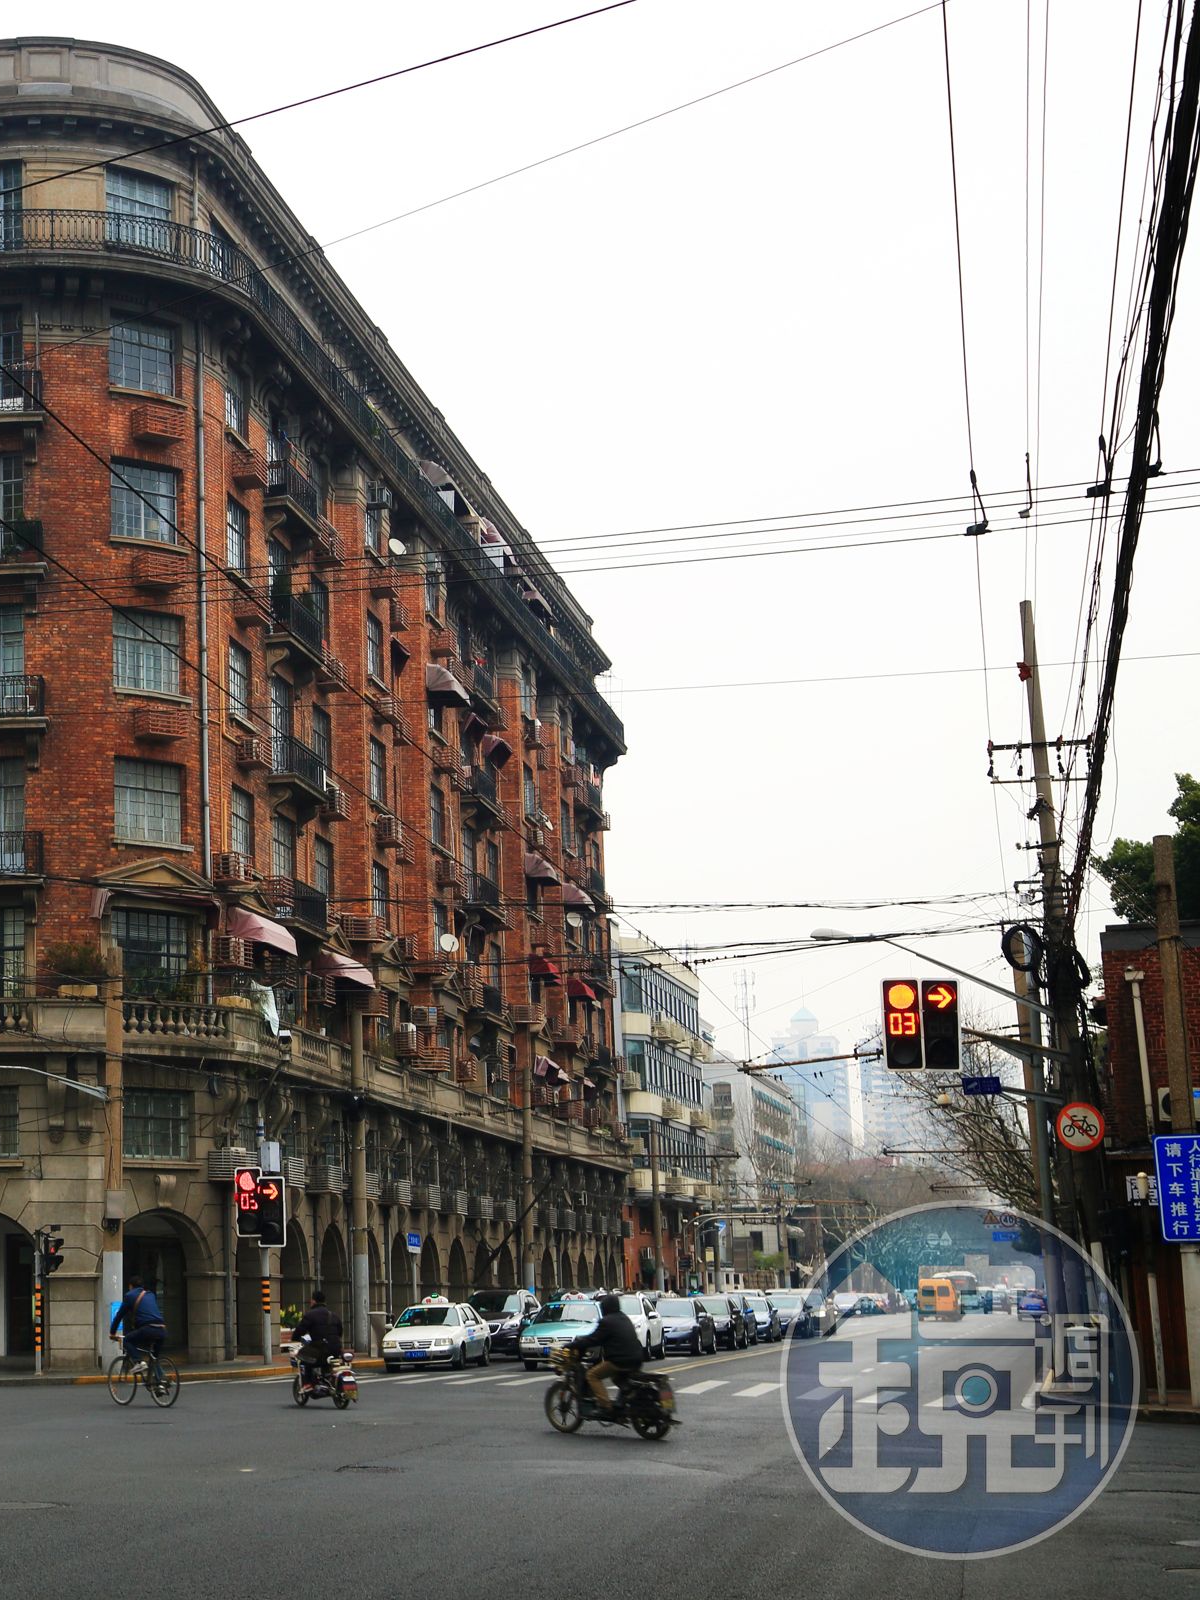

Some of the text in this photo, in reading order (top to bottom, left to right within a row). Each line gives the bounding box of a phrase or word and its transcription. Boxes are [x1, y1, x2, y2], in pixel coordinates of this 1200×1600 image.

[889, 1013, 916, 1035] 03
[1165, 1143, 1190, 1236] 请下车推行
